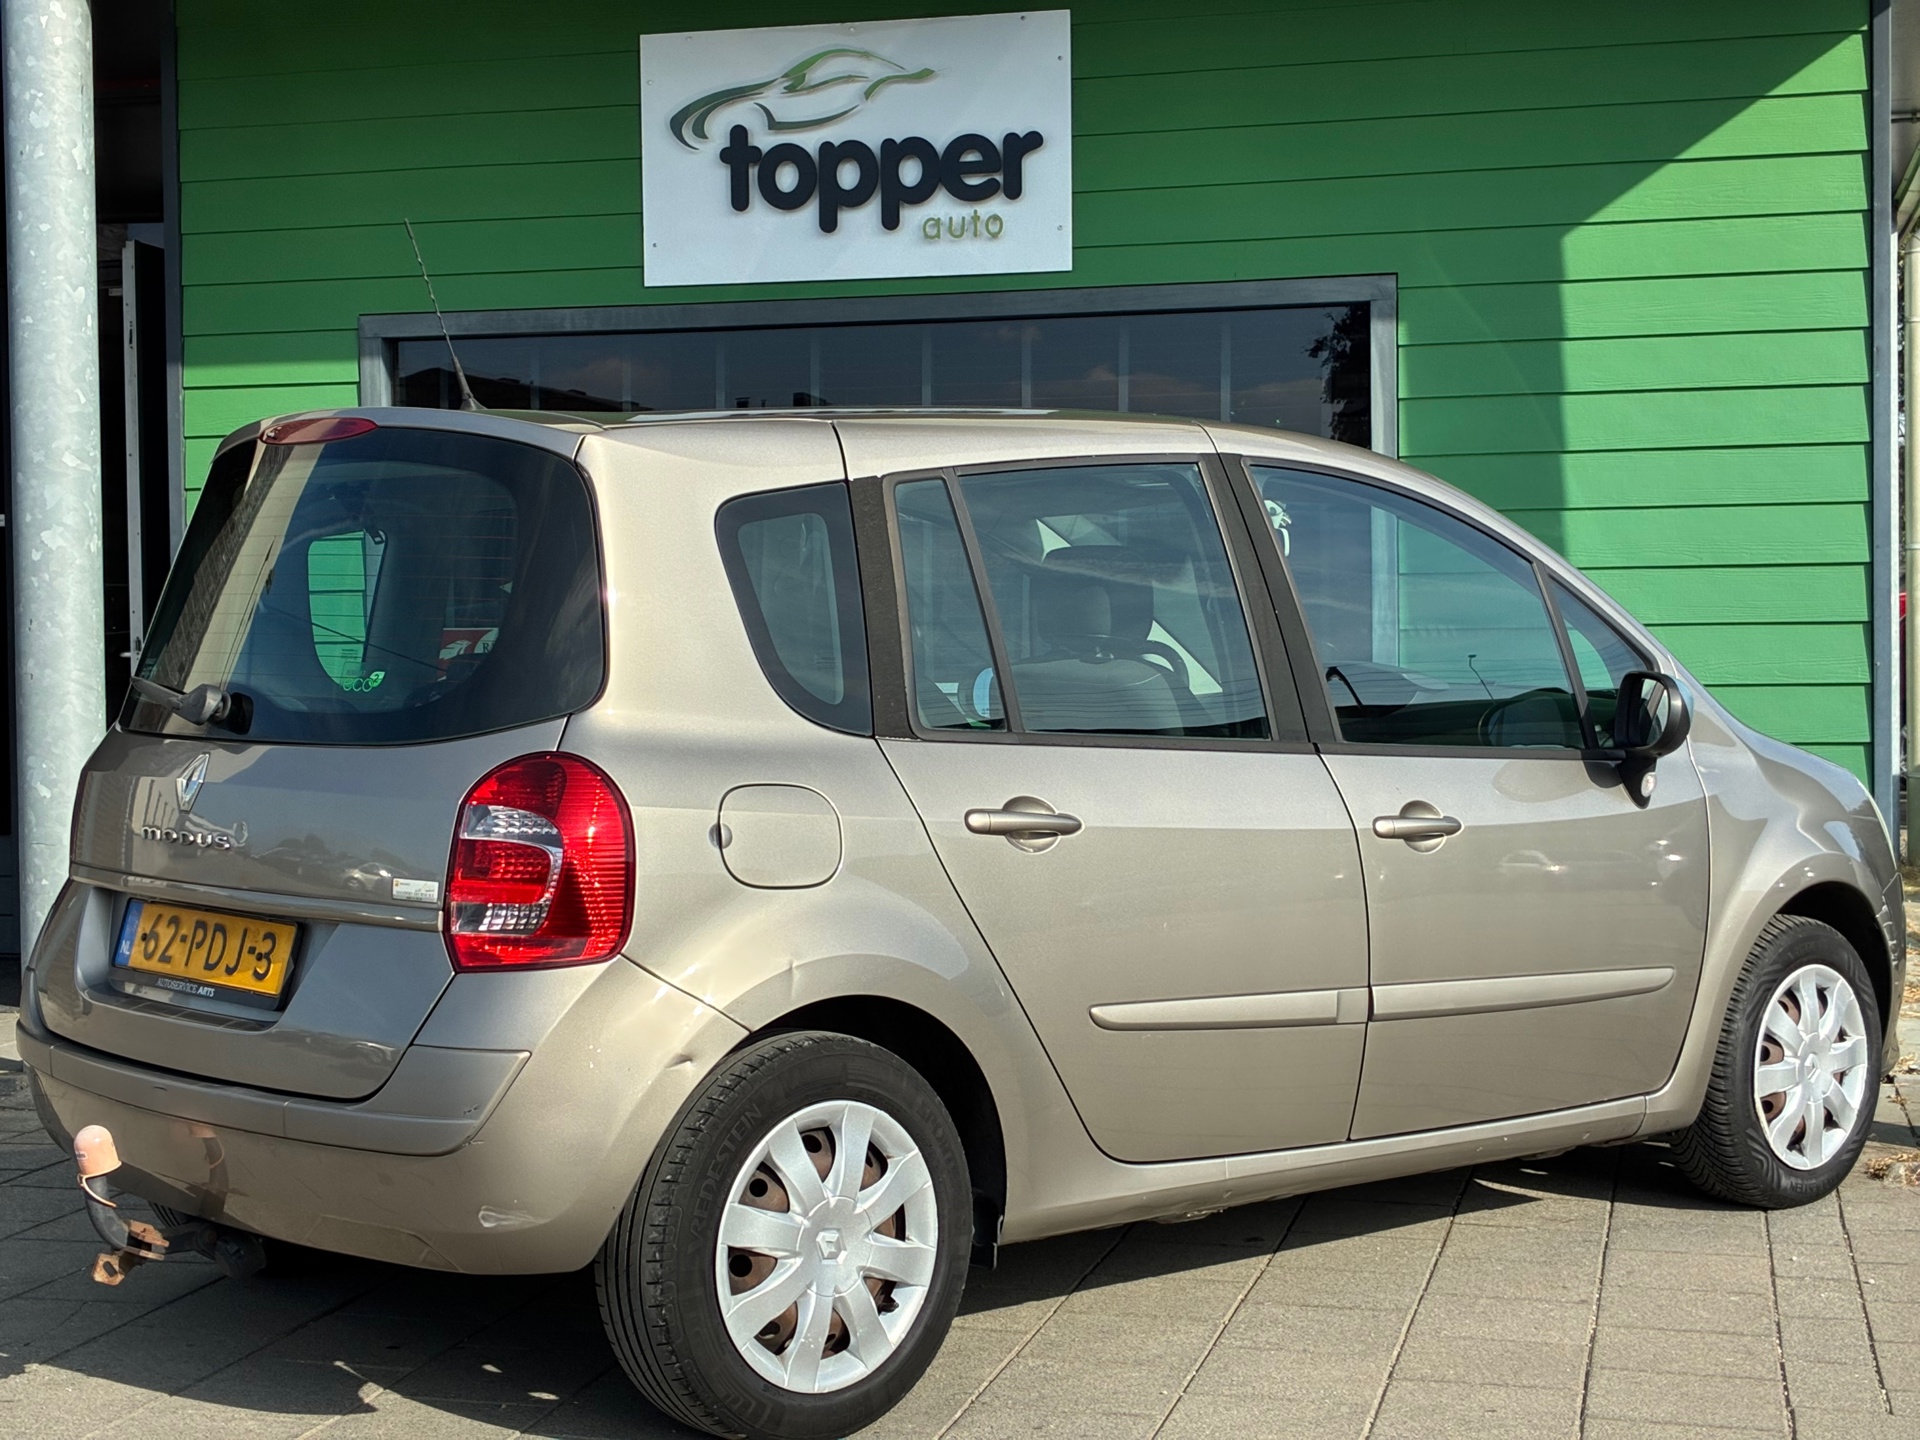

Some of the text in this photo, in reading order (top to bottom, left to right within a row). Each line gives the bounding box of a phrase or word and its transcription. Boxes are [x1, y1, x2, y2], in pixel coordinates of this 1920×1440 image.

[719, 124, 1044, 234] topper
[922, 209, 1004, 240] auto
[120, 940, 131, 955] NL
[142, 913, 277, 981] 62-PDJ-3
[155, 977, 215, 998] AUTOSERVICE ARTS
